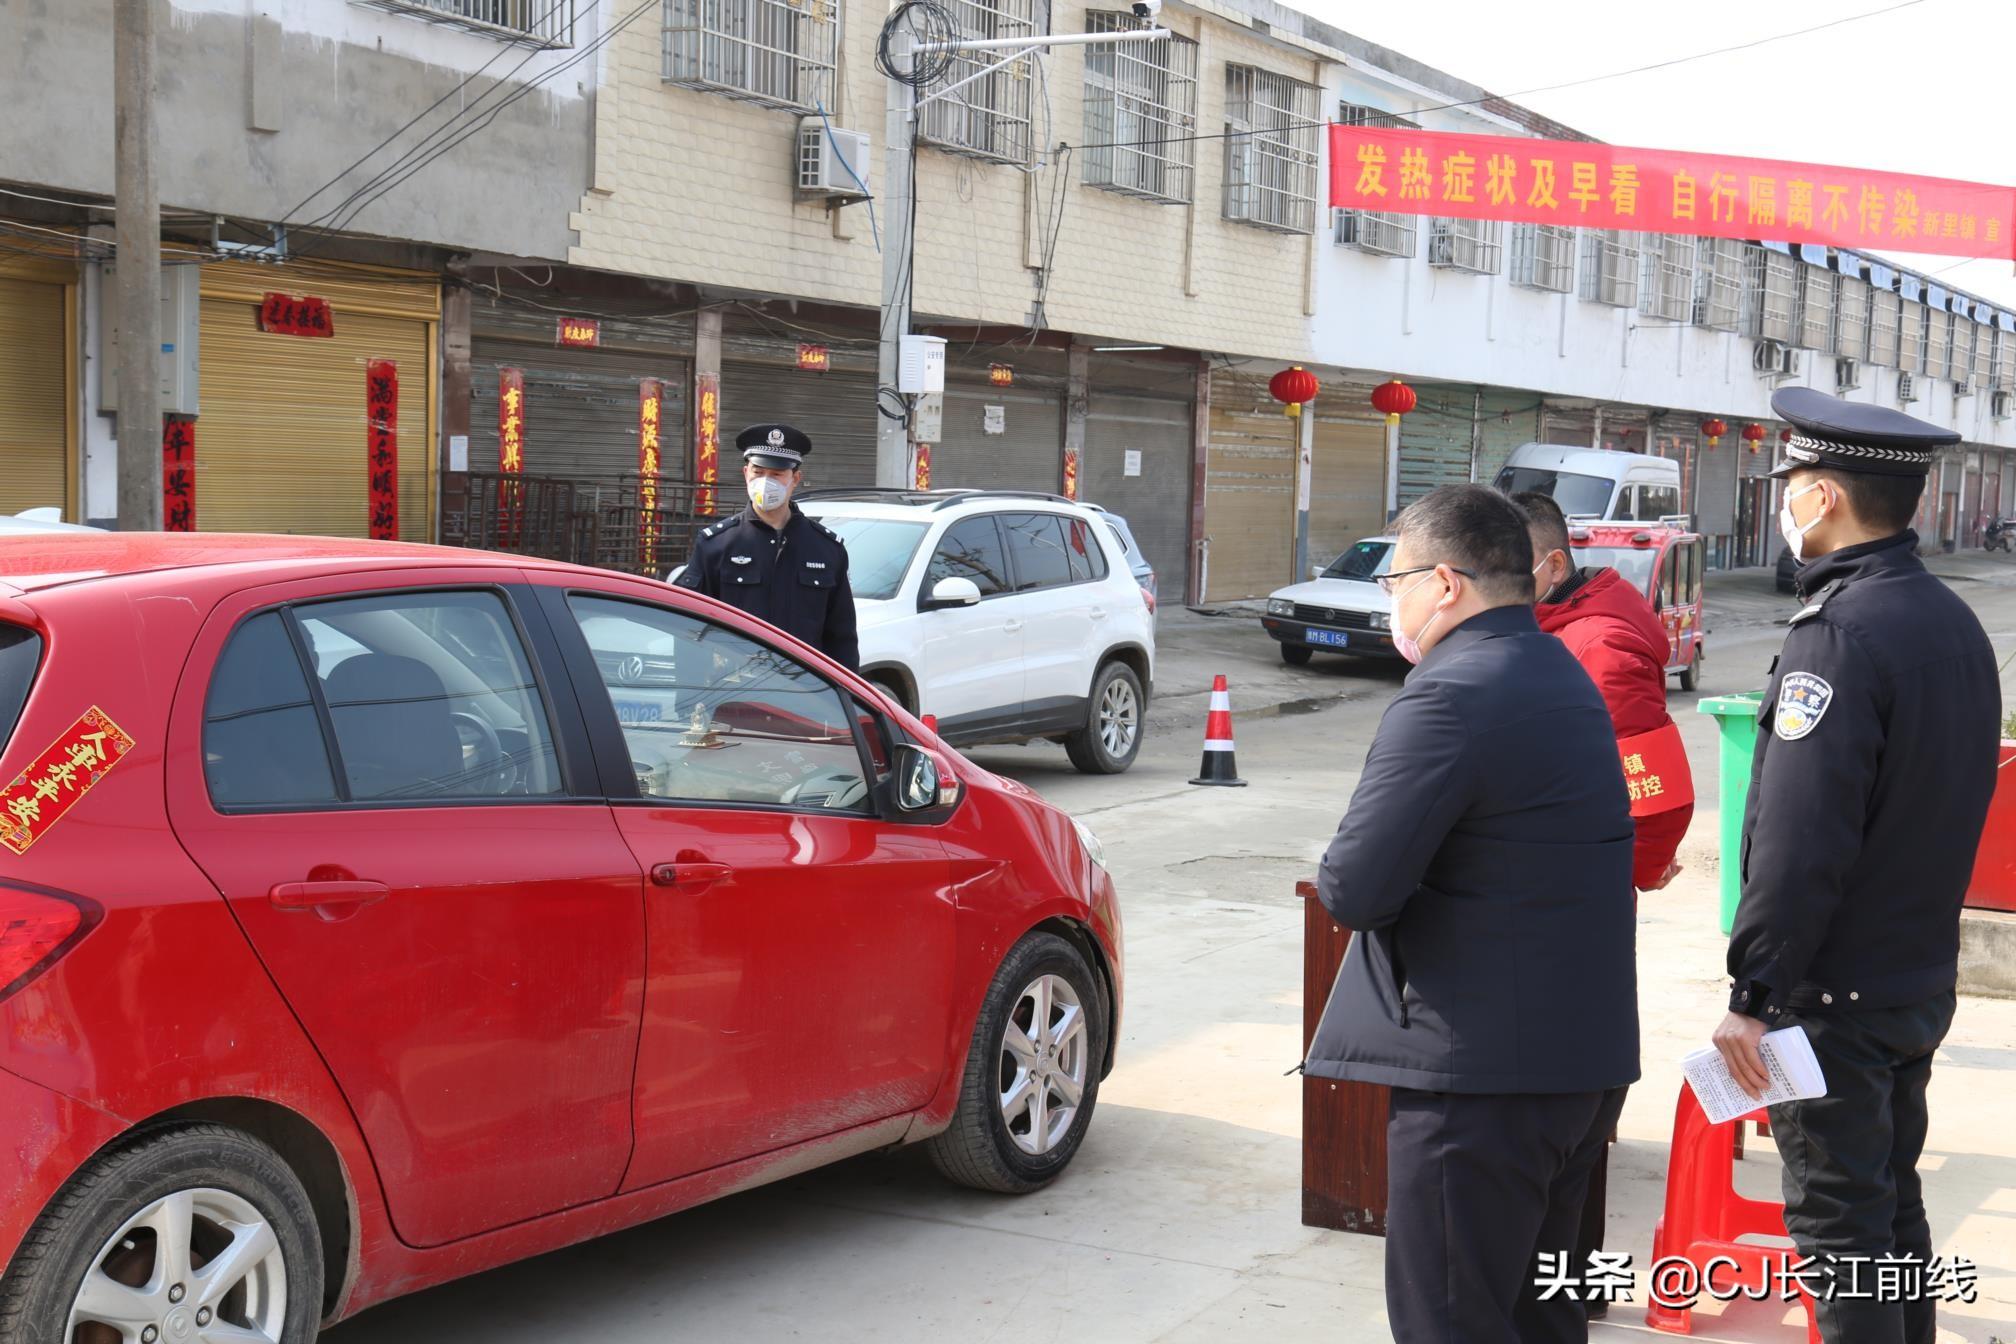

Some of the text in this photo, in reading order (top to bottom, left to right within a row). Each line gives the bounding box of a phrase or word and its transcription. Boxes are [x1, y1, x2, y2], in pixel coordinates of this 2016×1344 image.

[1355, 143, 1641, 217] 发热症状及早看
[1671, 167, 1920, 240] 自行隔离不传染
[1623, 753, 1646, 777] 镇
